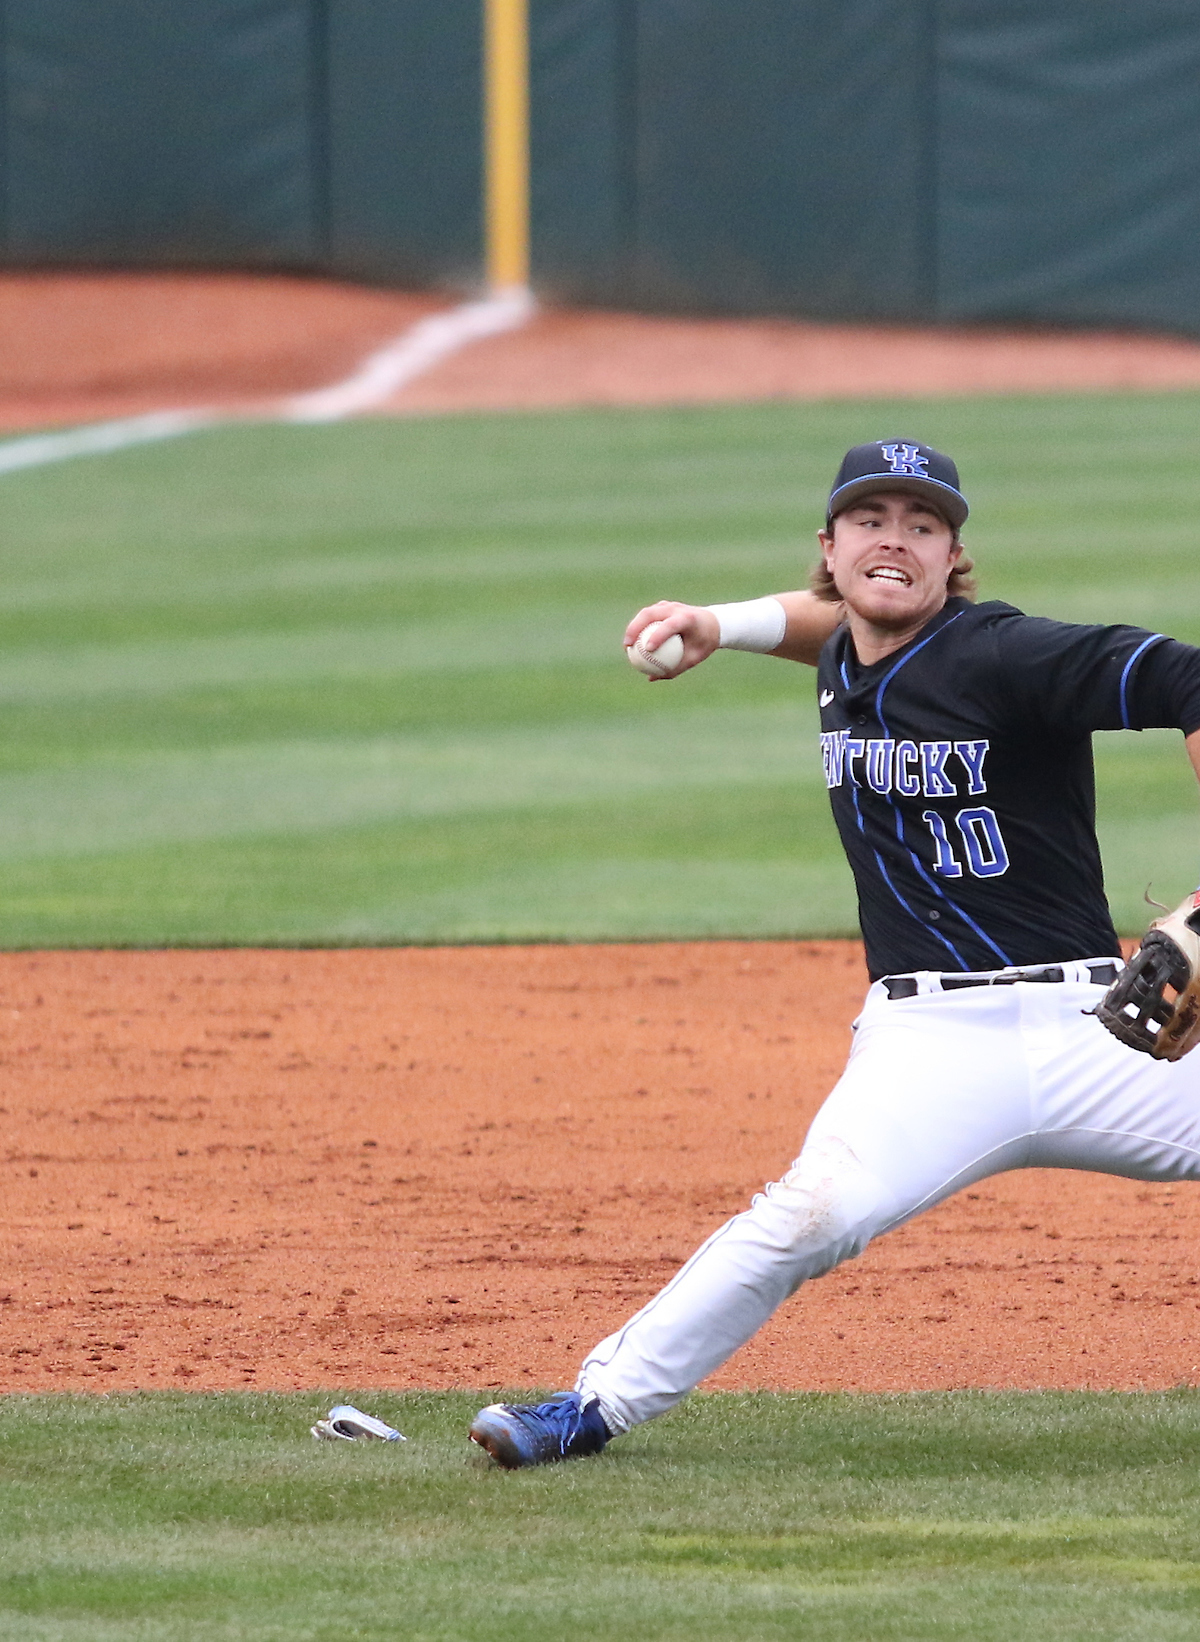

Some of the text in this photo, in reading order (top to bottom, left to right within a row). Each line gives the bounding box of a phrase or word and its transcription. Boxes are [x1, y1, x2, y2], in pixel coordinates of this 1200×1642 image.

[881, 443, 929, 477] UK
[820, 730, 989, 797] ENTUCKY
[922, 806, 1010, 878] 10
